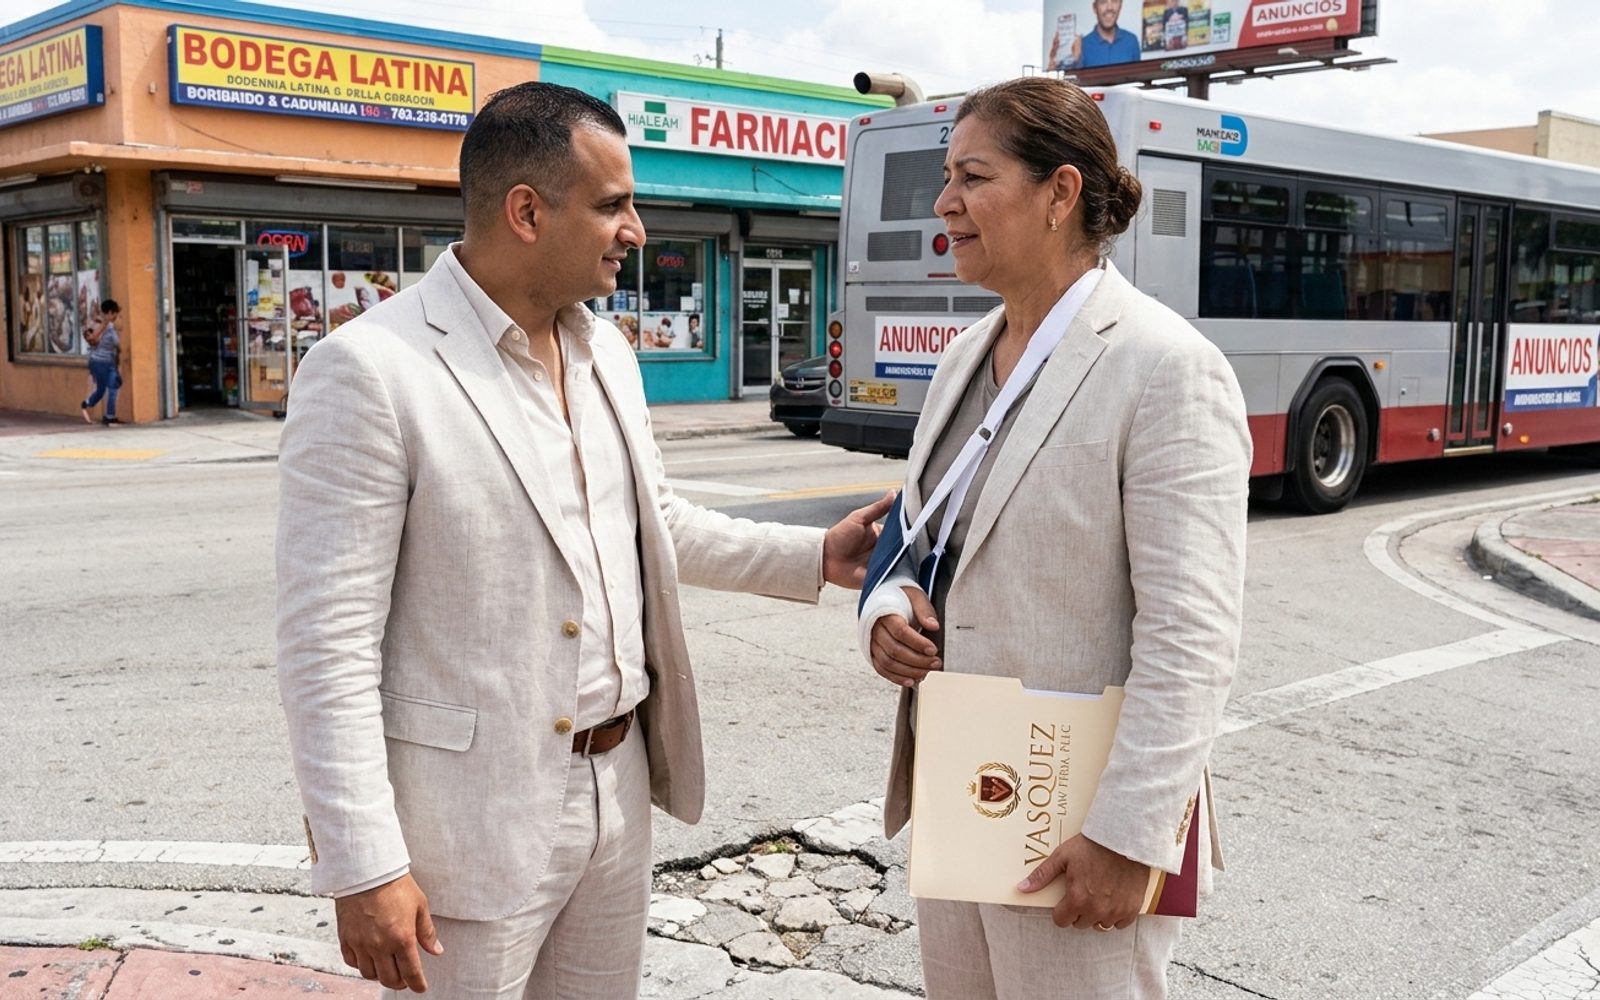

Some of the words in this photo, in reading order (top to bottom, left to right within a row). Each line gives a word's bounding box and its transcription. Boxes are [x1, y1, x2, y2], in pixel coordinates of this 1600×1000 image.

[1256, 0, 1342, 22] ANUNCIOS
[30, 34, 84, 81] LATINA
[184, 33, 338, 82] BODEGA
[350, 54, 468, 96] LATINA
[268, 95, 278, 107] &
[290, 82, 330, 96] LATINA
[691, 107, 846, 160] FARMACI
[879, 325, 968, 354] ANUNCIO
[1510, 338, 1592, 375] ANUNCIOS
[1024, 722, 1057, 866] VASQUEZ
[1057, 791, 1068, 816] LAW
